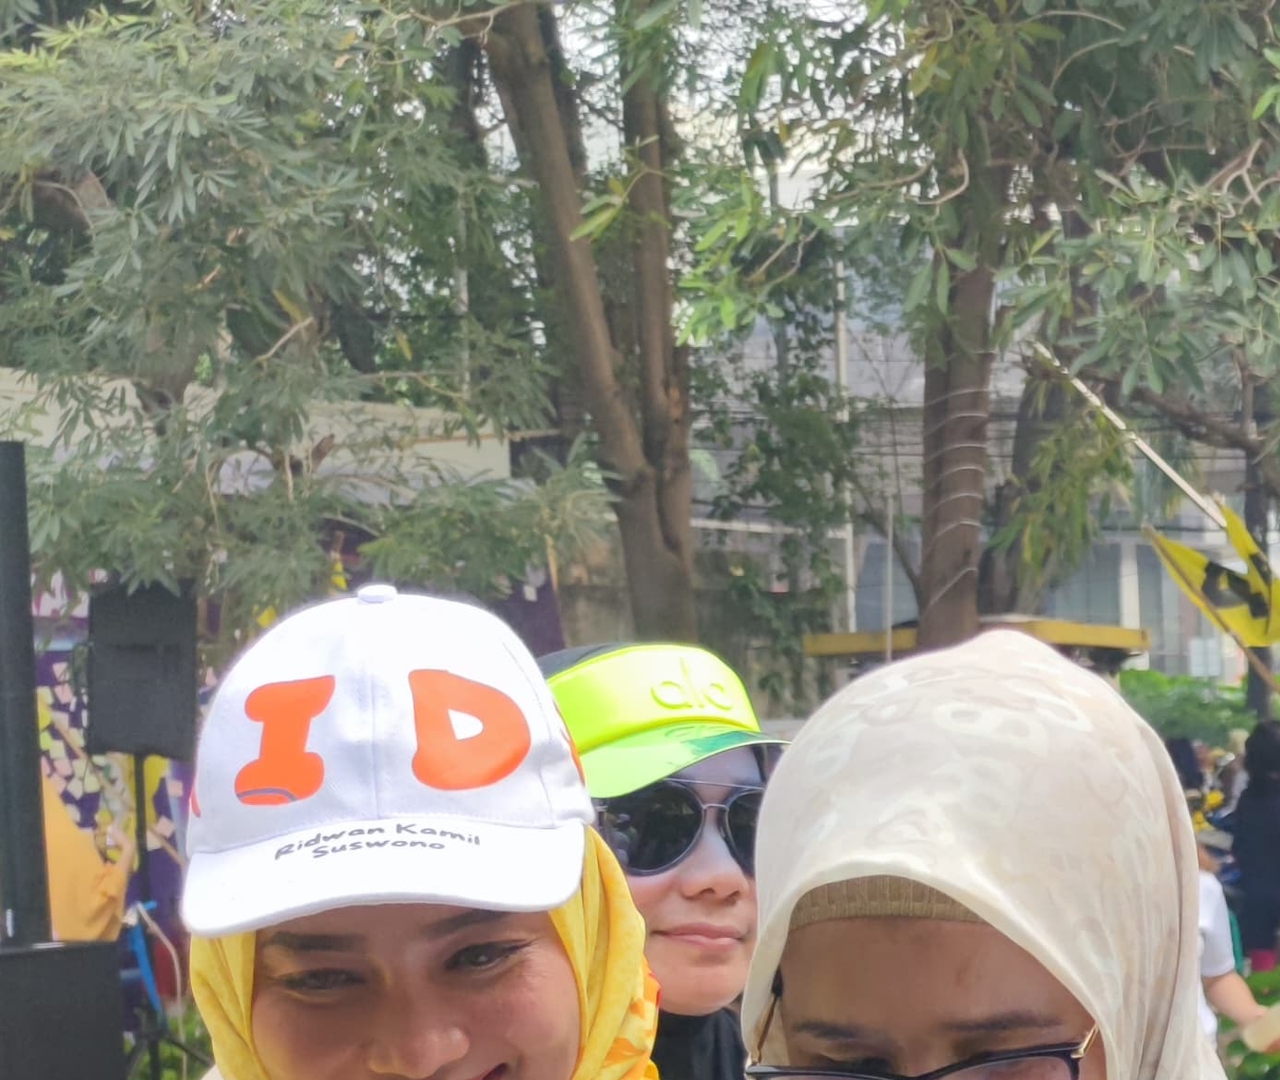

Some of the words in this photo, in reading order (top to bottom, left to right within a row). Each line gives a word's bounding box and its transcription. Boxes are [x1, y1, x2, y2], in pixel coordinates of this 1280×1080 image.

[275, 826, 386, 859] Ridwan
[395, 823, 481, 846] Kamil
[312, 839, 446, 859] Suswono
